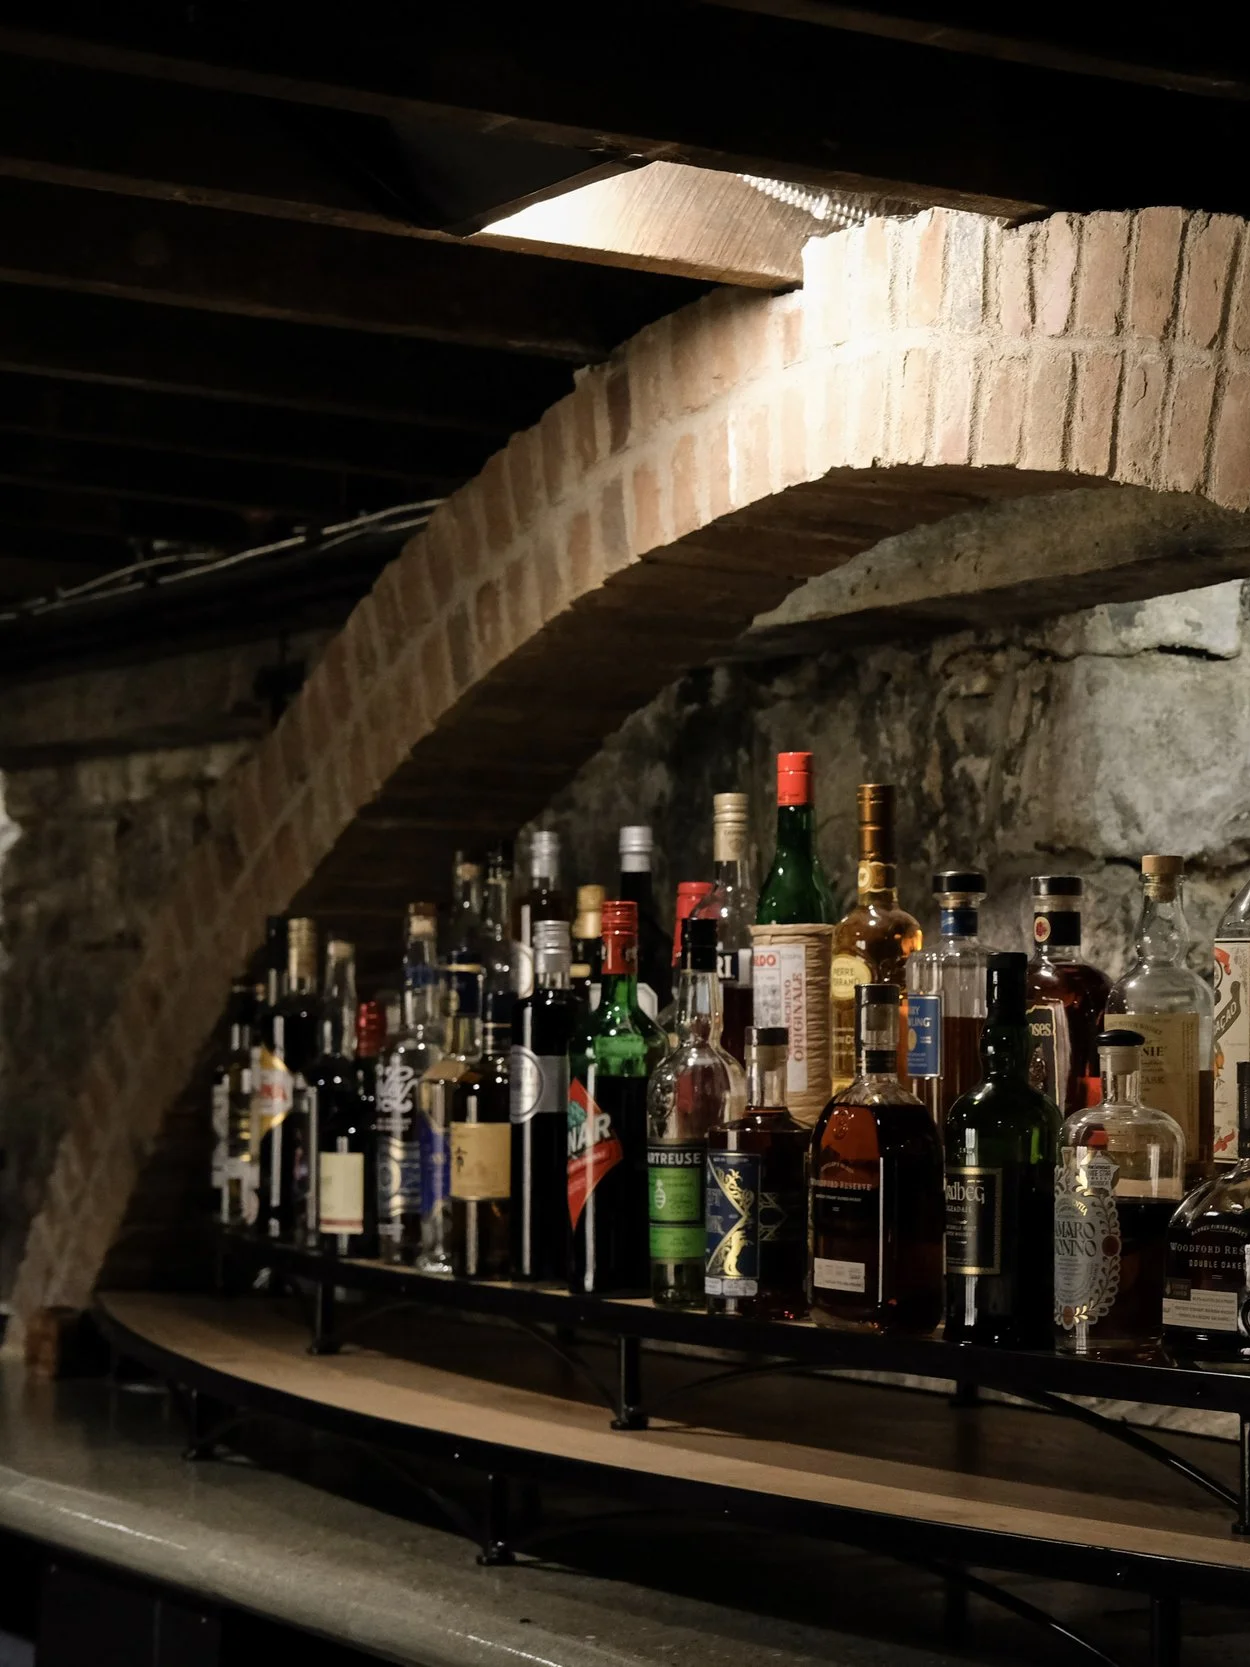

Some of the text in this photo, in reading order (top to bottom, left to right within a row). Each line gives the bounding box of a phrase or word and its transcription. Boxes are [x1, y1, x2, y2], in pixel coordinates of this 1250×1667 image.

[792, 972, 804, 1063] ORIGINALE
[1169, 1241, 1221, 1255] WOODFORD
[1188, 1258, 1218, 1269] DOUBLE
